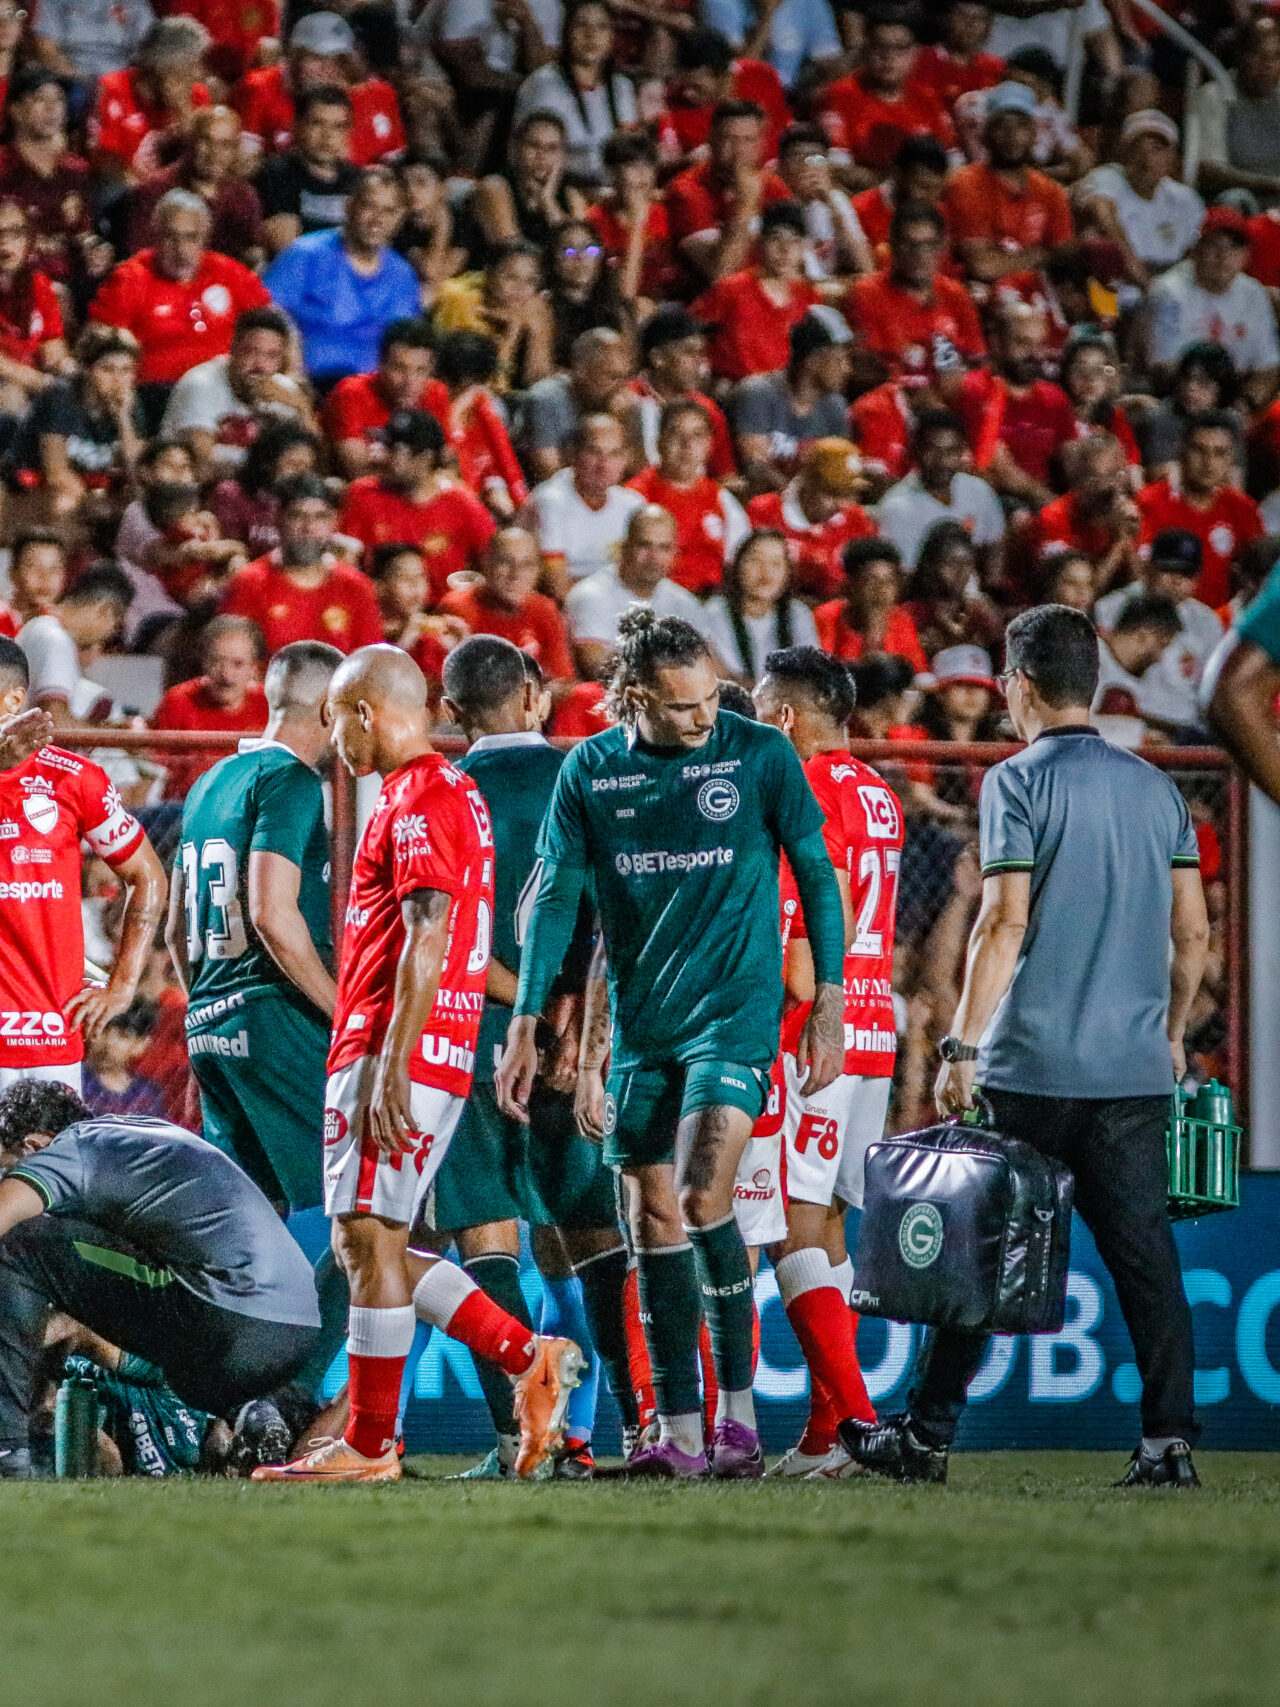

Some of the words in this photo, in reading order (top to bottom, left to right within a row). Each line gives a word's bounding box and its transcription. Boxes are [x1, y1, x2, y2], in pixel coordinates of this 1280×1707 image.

[630, 846, 734, 874] BETesporte
[846, 846, 903, 958] 27
[794, 1112, 839, 1161] F8
